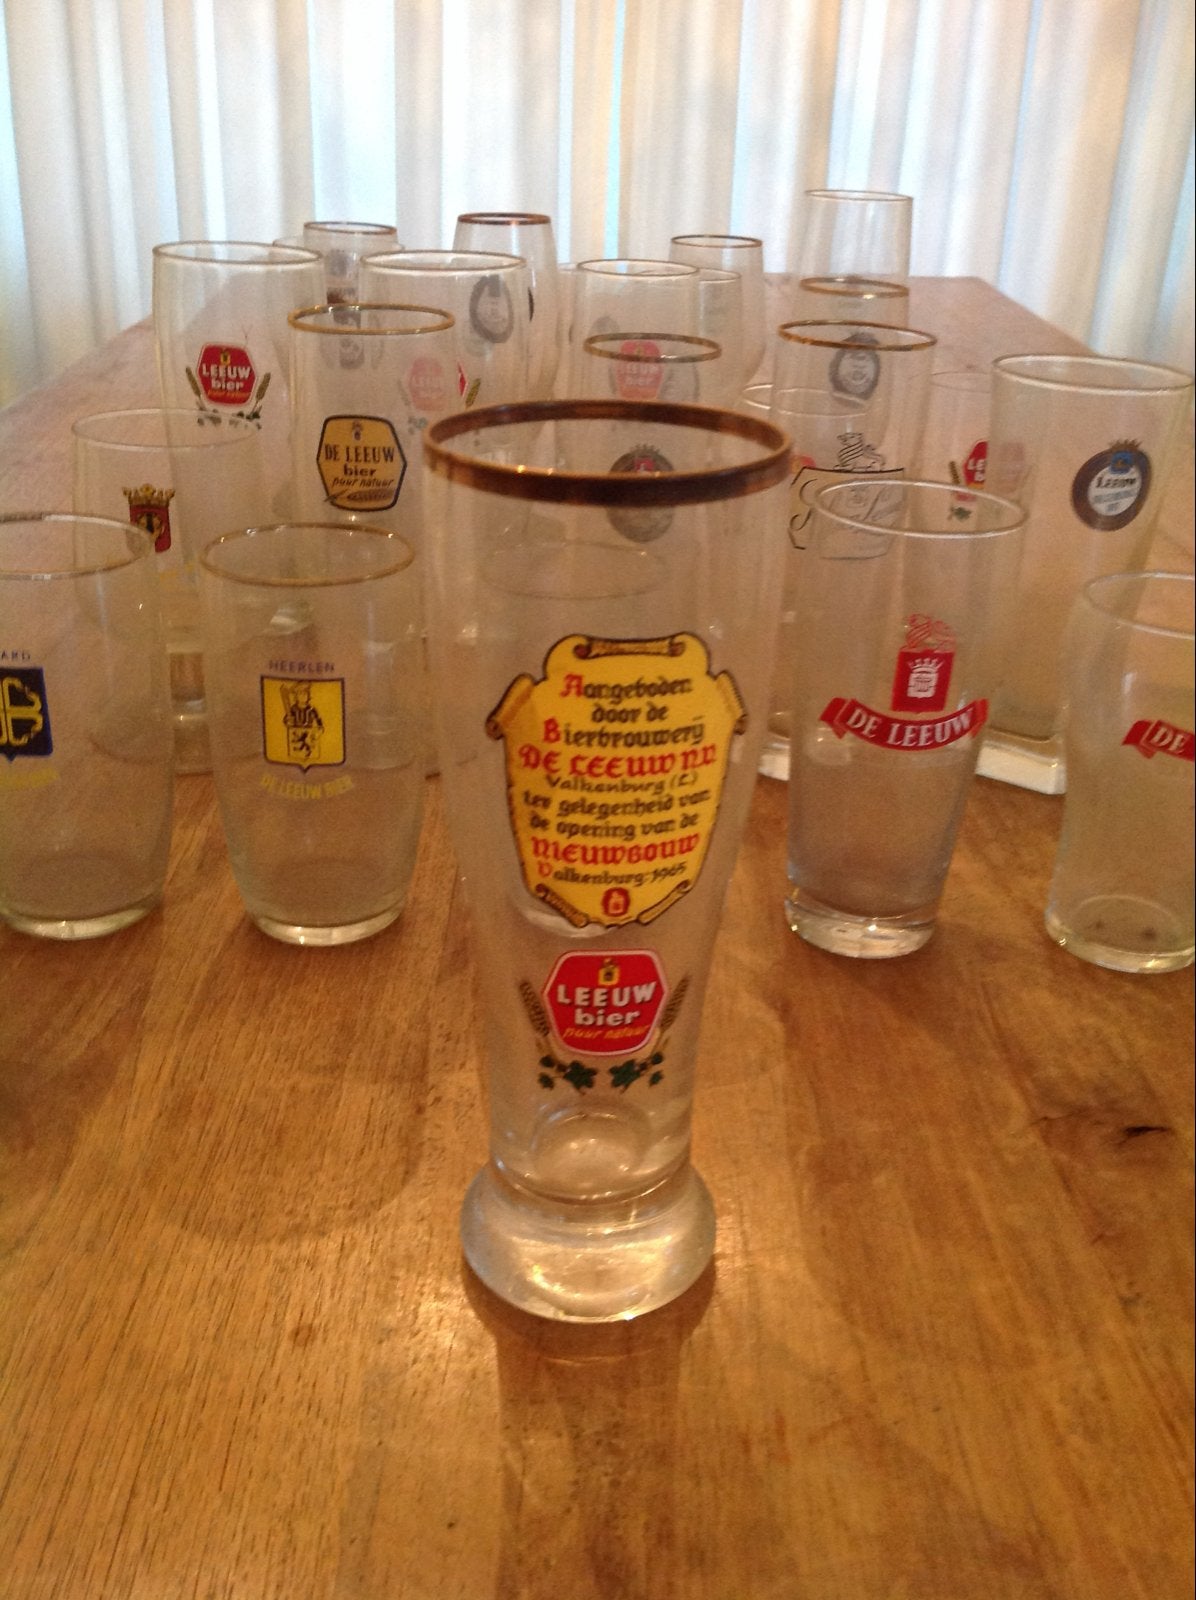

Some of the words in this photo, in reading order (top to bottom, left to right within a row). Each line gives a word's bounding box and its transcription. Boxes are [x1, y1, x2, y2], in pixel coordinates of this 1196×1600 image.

[202, 363, 251, 379] LEEUW
[211, 378, 245, 391] bier
[324, 443, 341, 461] DE
[345, 445, 395, 463] LEEUW
[343, 463, 377, 476] bier
[359, 478, 395, 489] natuur
[268, 660, 335, 674] HEERLEN
[560, 673, 692, 705] Aangeboden
[591, 702, 641, 724] door
[646, 701, 668, 722] de
[847, 708, 881, 738] DE
[887, 707, 973, 747] LEEUW
[1150, 726, 1189, 755] DE
[519, 743, 562, 774] DE
[569, 752, 676, 779] LEEUW
[546, 774, 665, 796] Valkenburg
[557, 793, 674, 821] gelegenheid
[679, 789, 710, 808] van
[530, 813, 549, 831] de
[556, 820, 636, 842] opening
[641, 818, 676, 836] van
[679, 812, 699, 829] de
[531, 833, 700, 865] NIEUWBOUW
[556, 981, 657, 1007] LEEUW
[574, 1008, 641, 1027] bier
